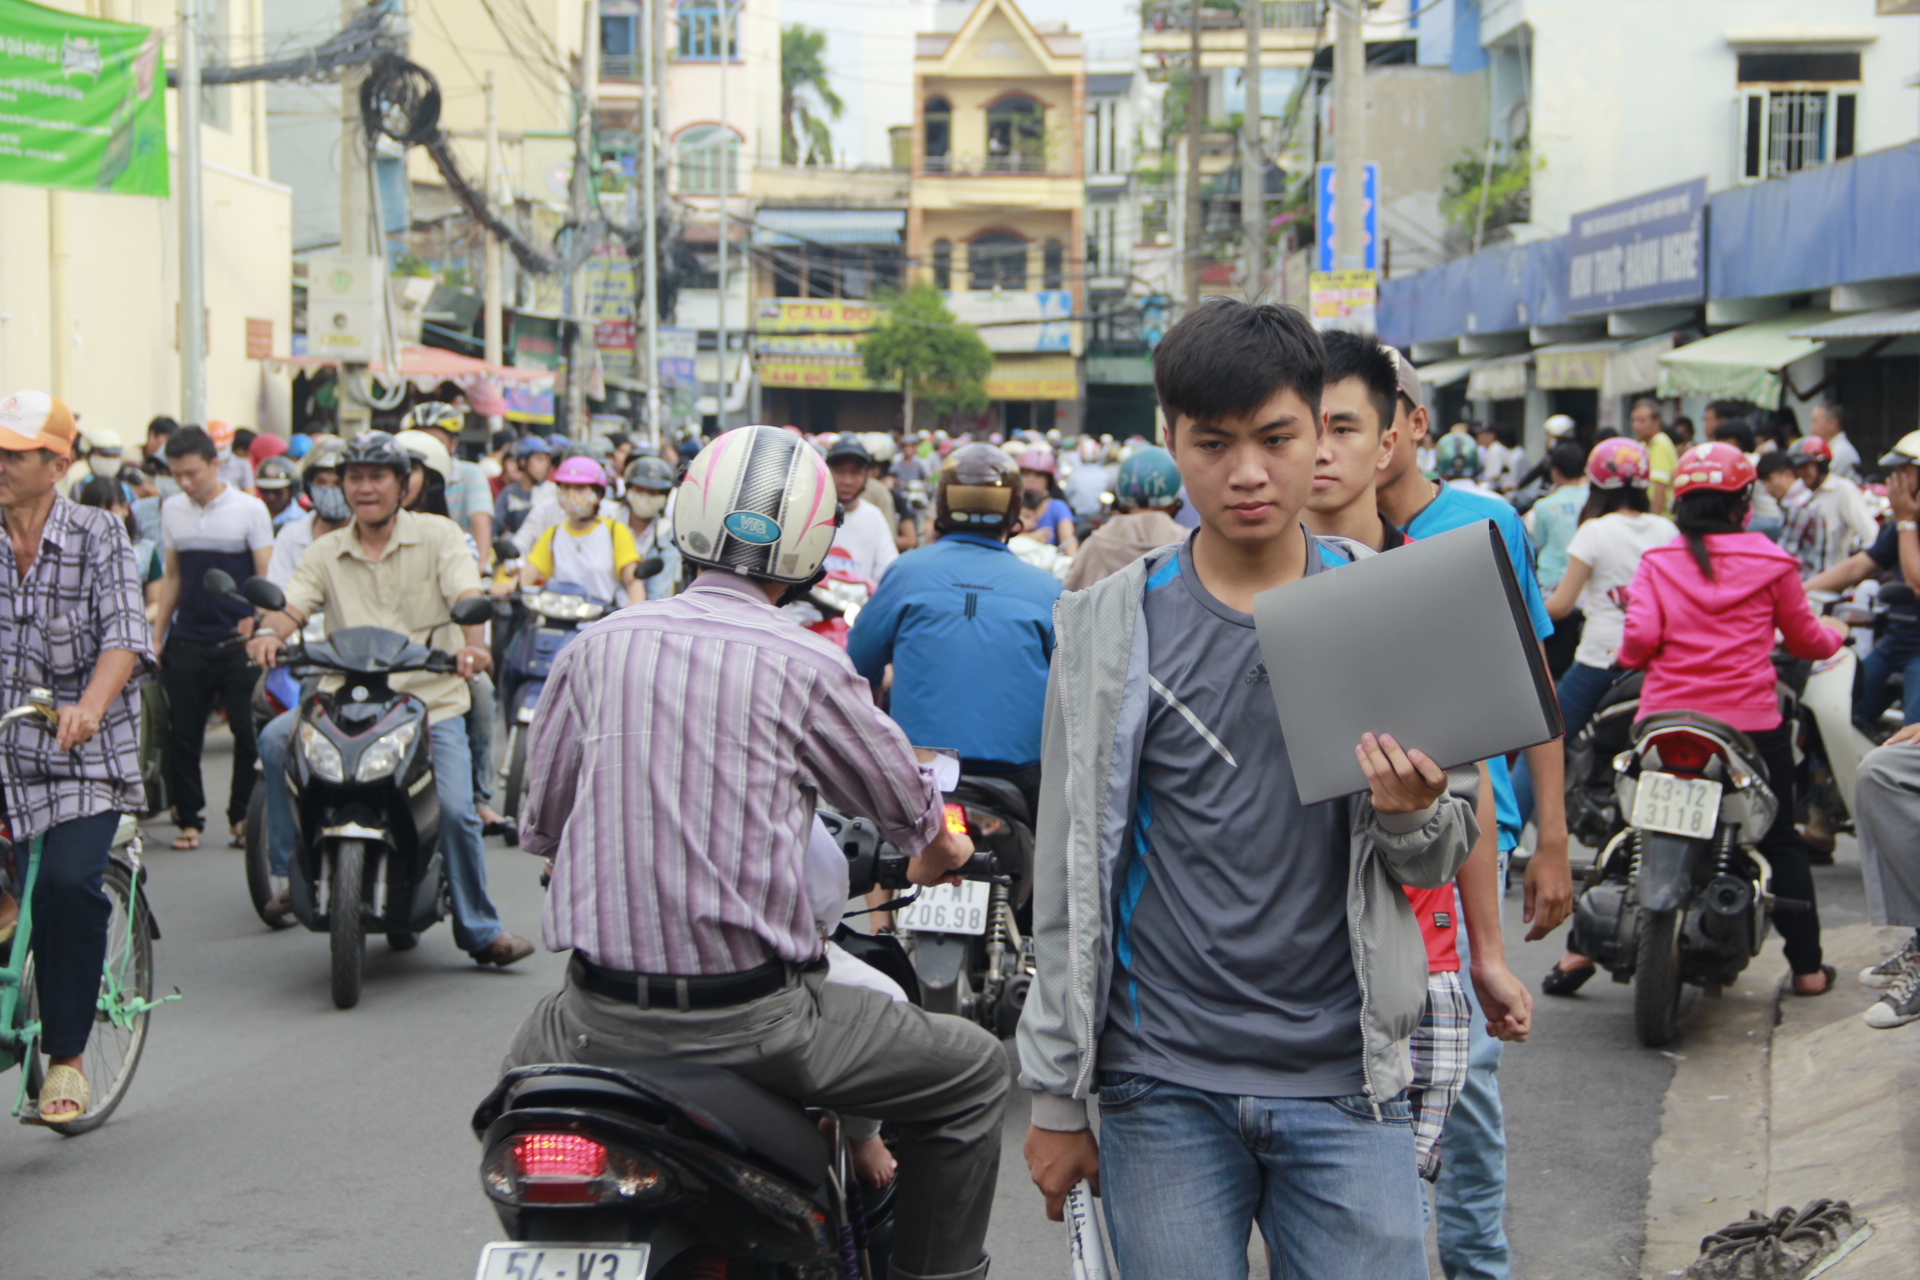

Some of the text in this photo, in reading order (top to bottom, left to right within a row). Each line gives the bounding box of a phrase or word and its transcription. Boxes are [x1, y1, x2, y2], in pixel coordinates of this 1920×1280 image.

[1650, 779, 1706, 808] 43-T2
[1644, 803, 1702, 831] 3118
[902, 903, 981, 930] 206.98
